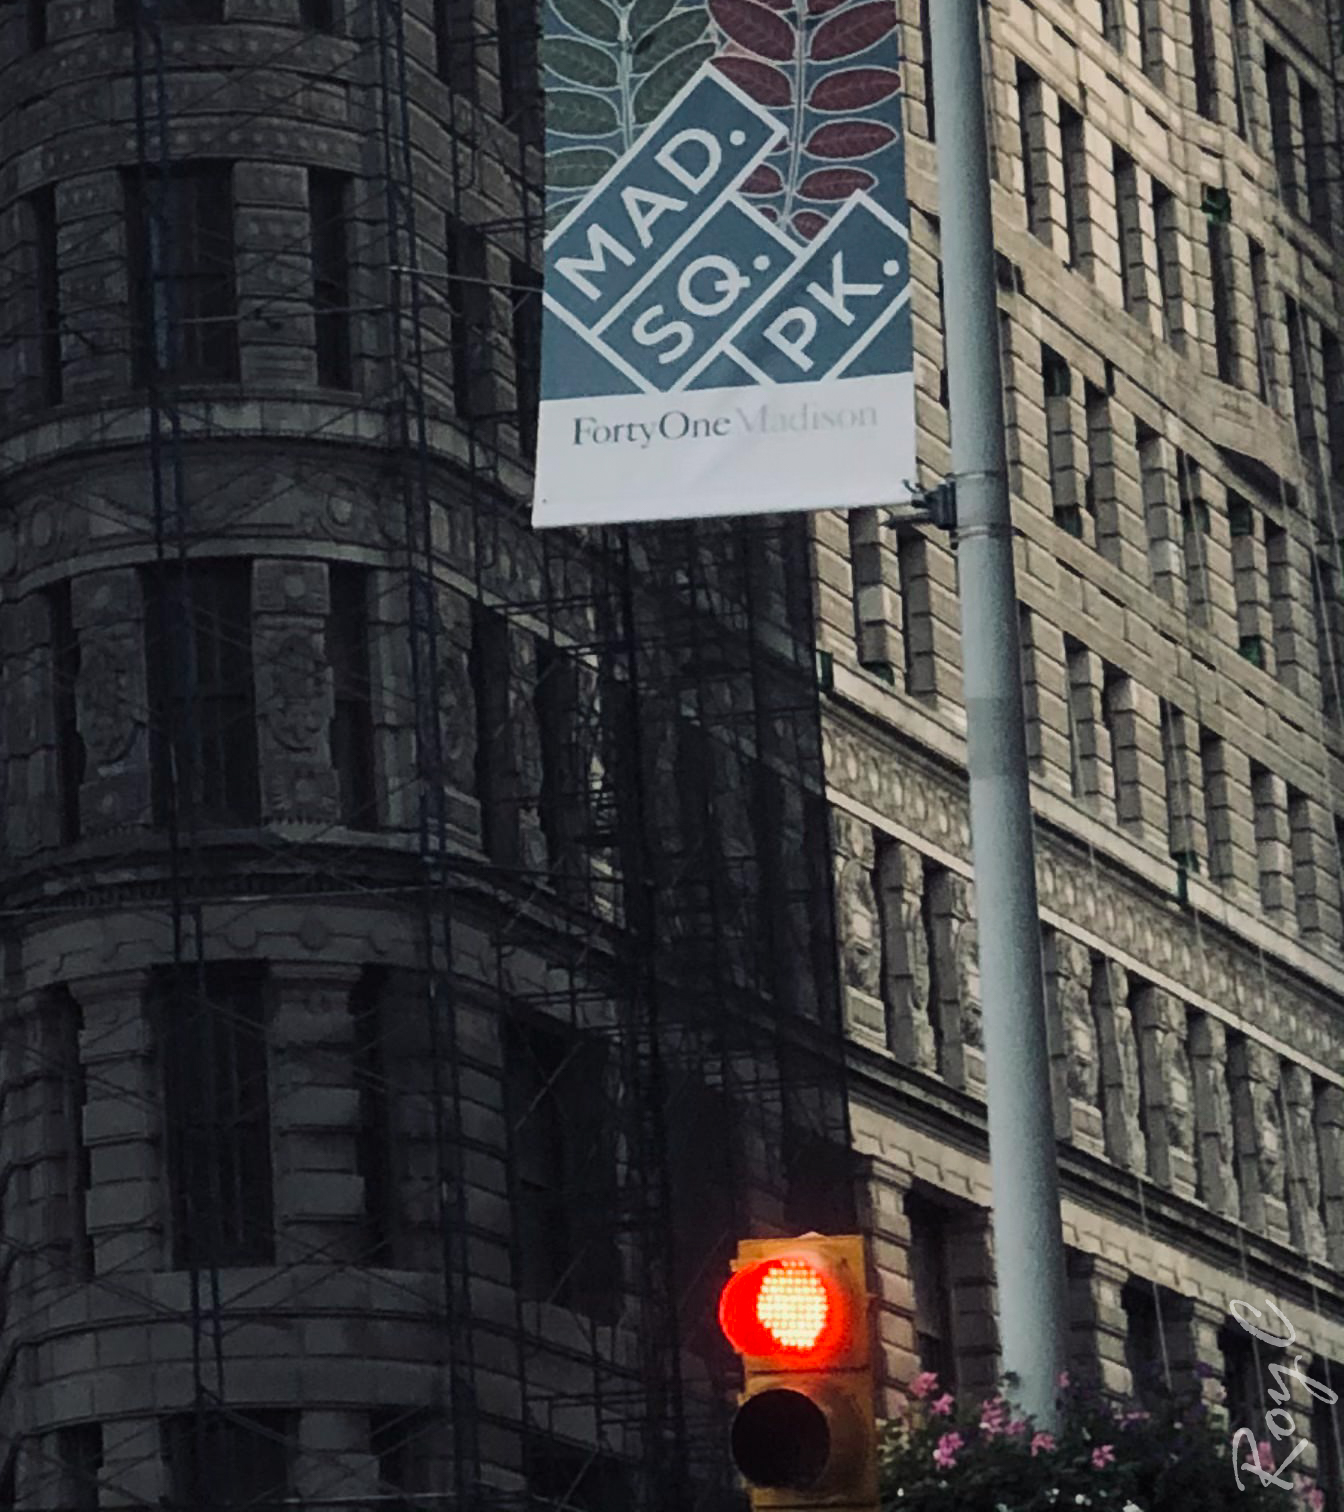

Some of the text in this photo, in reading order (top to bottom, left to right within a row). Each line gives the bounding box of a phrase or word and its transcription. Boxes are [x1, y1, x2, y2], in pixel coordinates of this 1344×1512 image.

[554, 128, 746, 302] MAD.
[631, 254, 771, 364] SQ.
[763, 251, 900, 372] PK.
[734, 403, 879, 435] Madison
